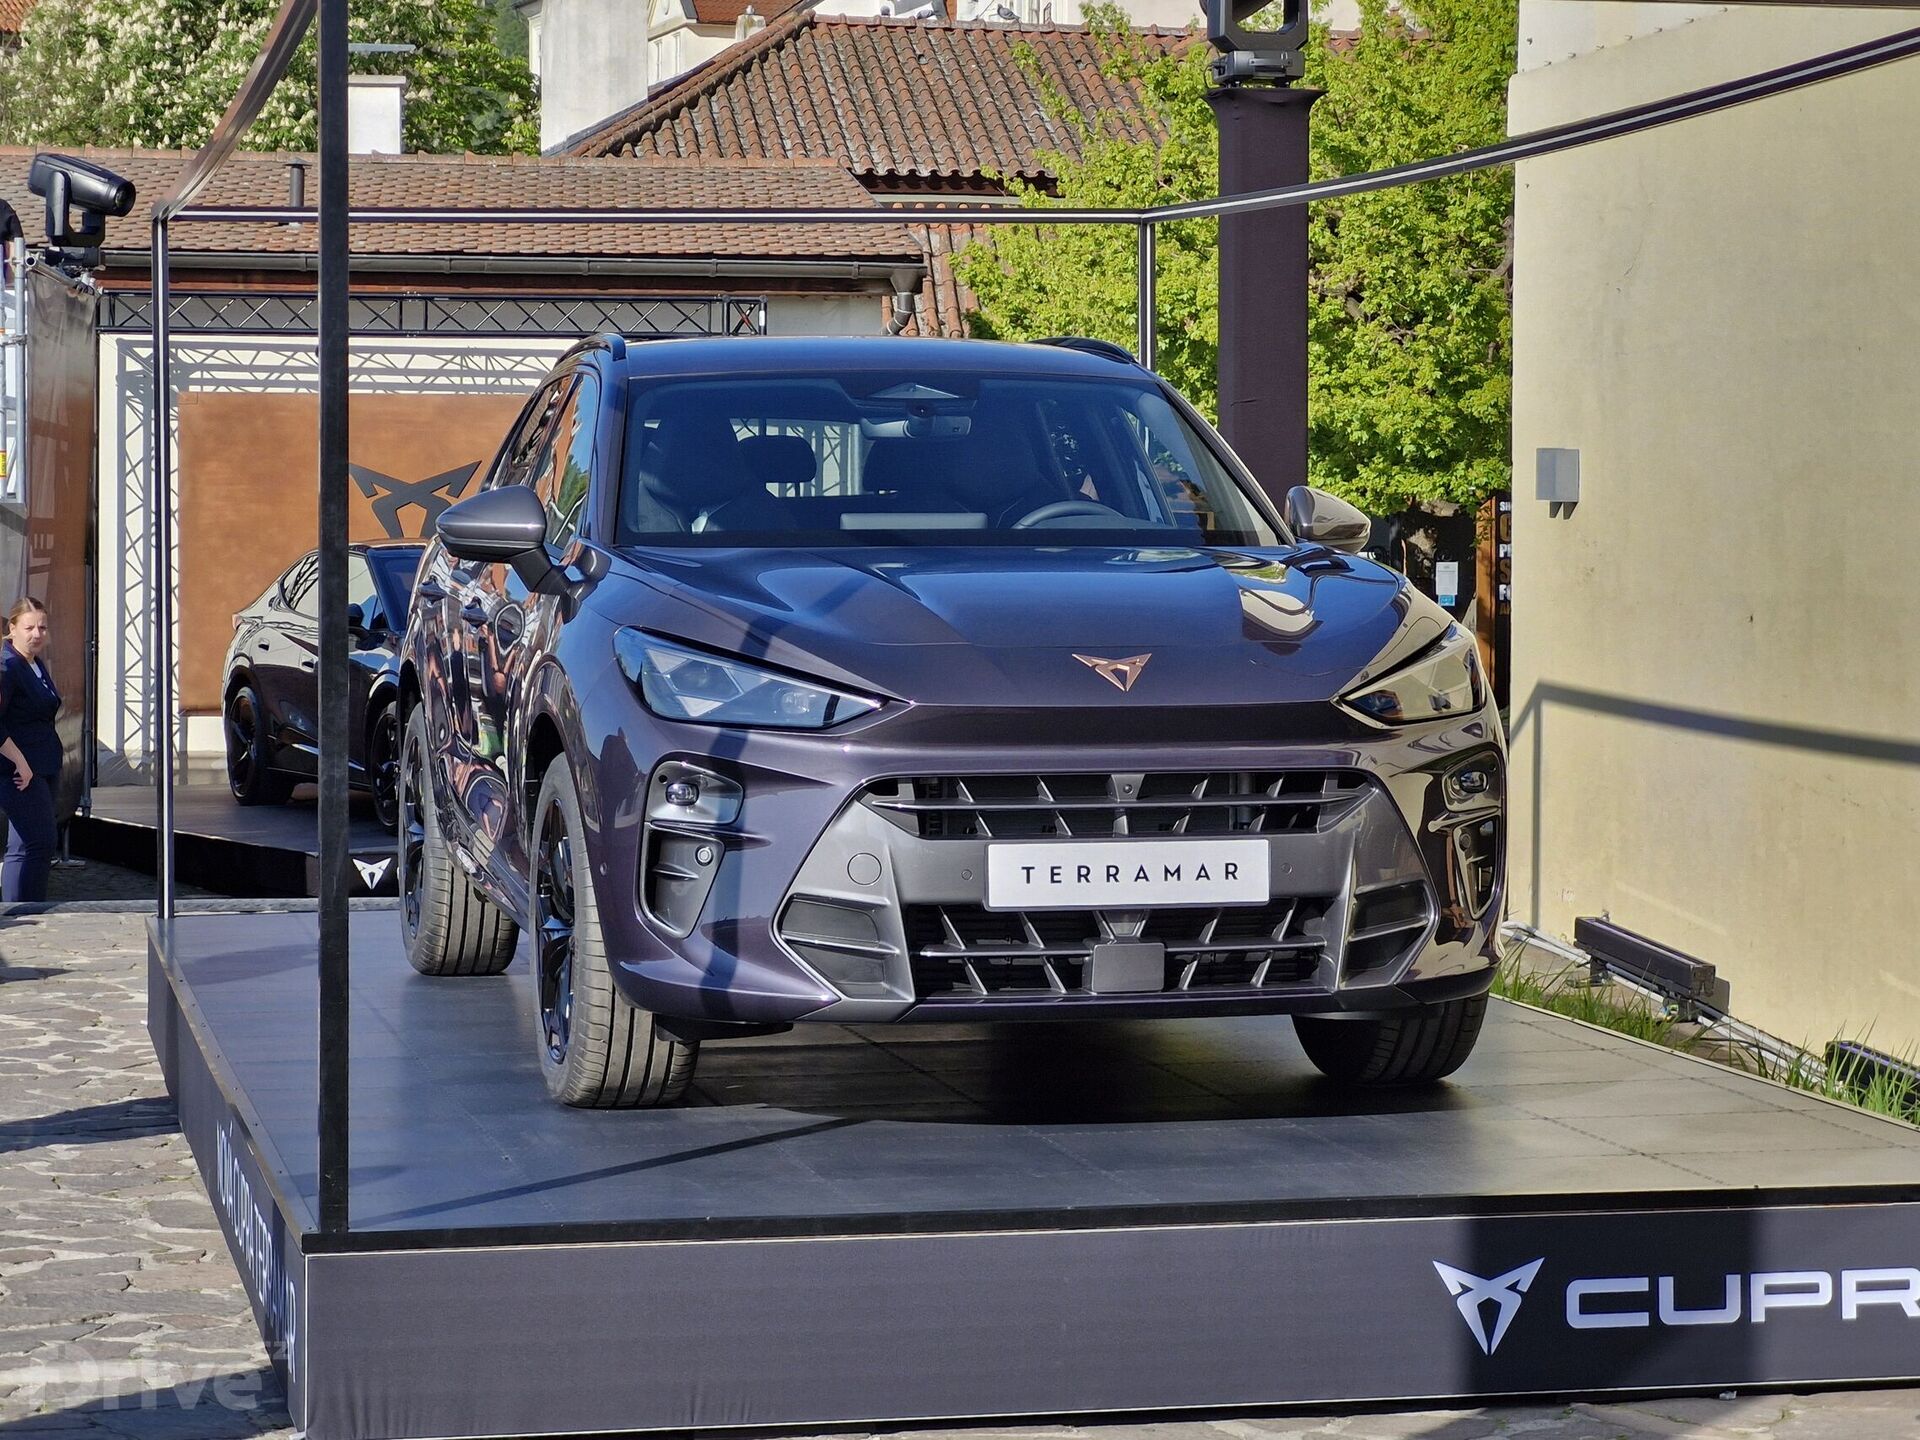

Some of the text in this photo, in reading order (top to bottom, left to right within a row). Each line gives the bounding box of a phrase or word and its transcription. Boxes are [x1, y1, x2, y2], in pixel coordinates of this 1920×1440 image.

[1020, 862, 1239, 884] TERRAMAR
[233, 1157, 255, 1280] CUPRA
[254, 1202, 296, 1384] TERRAMAR
[1565, 1266, 1920, 1330] CUPR
